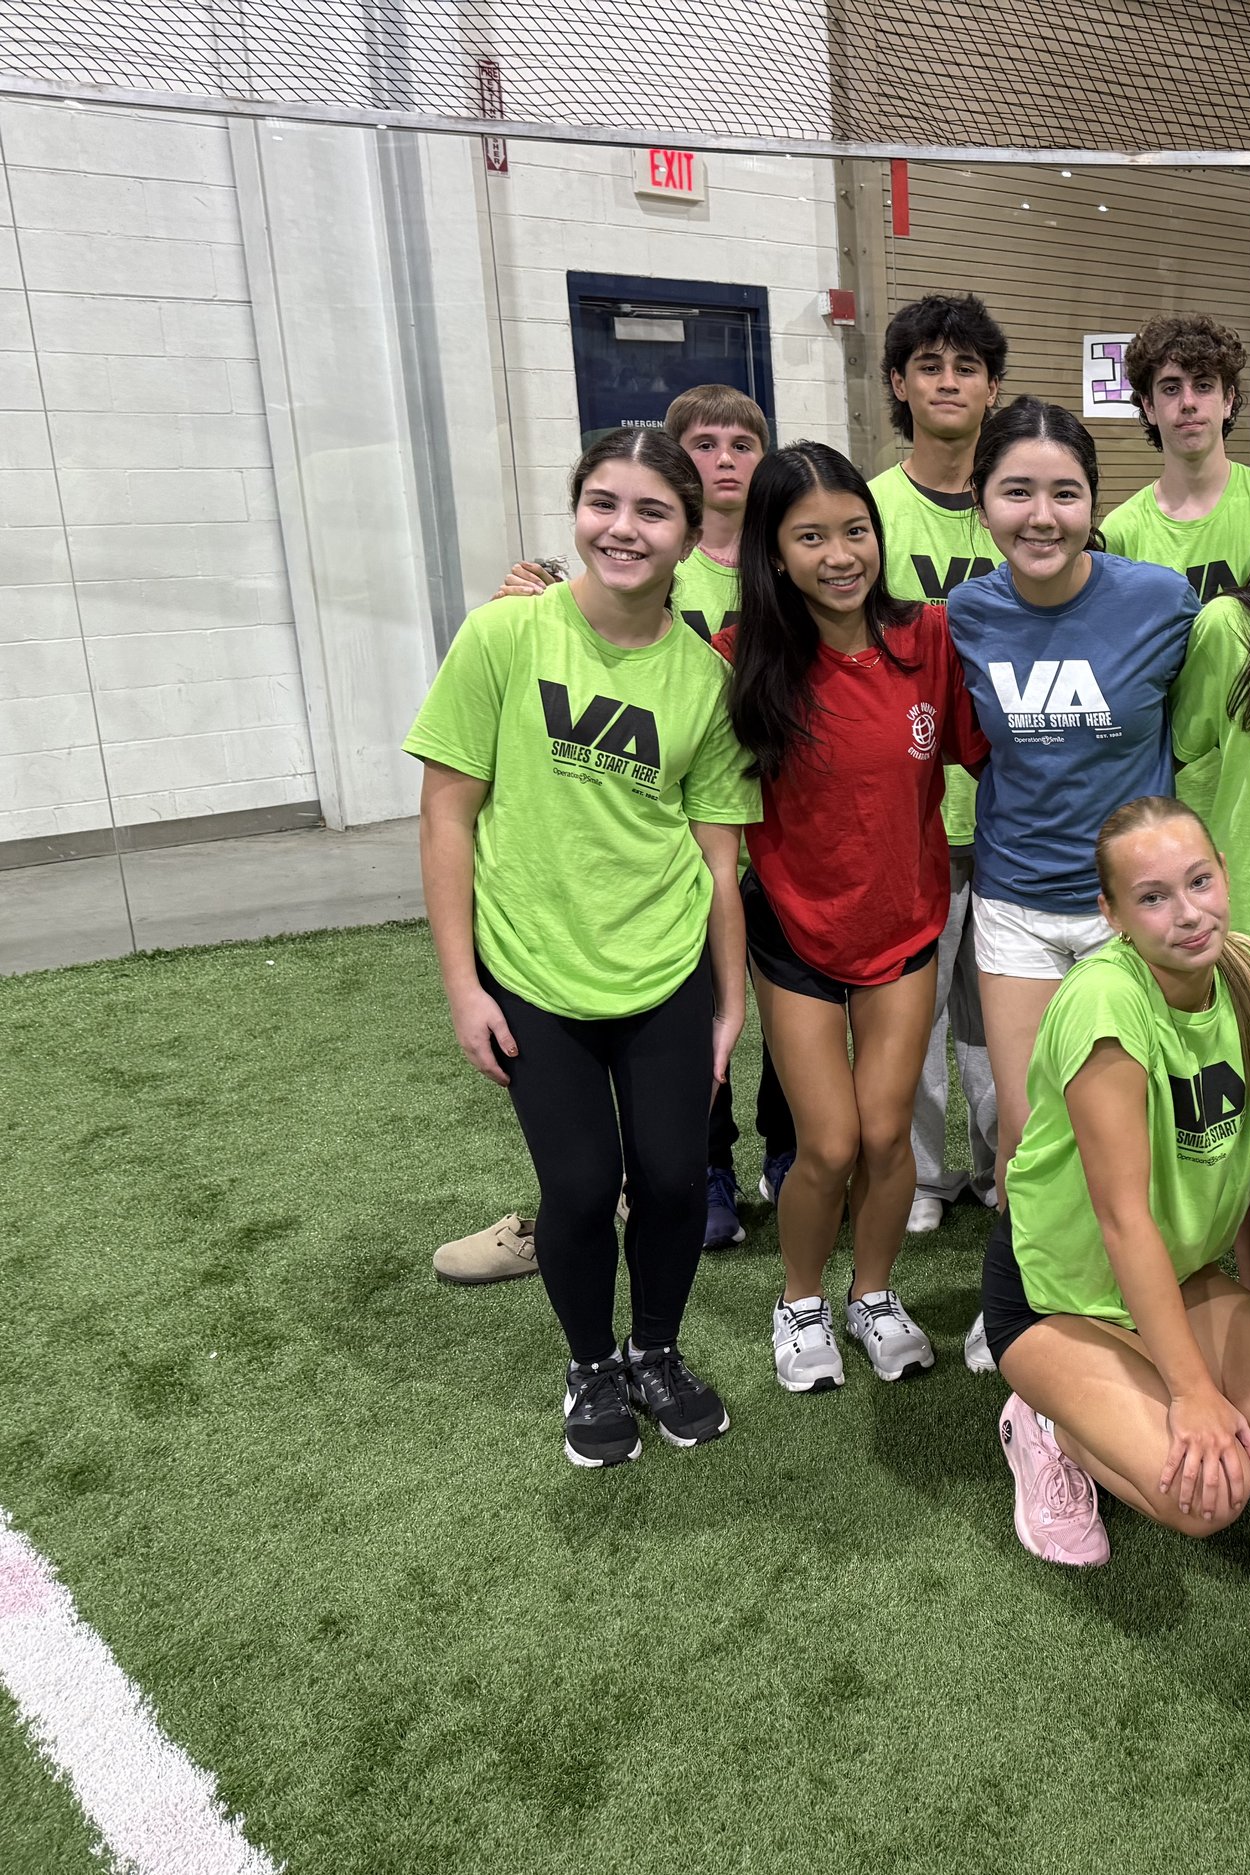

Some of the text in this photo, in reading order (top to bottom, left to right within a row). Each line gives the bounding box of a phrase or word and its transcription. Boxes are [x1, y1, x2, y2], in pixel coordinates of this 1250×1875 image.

[649, 148, 694, 192] EXIT
[988, 659, 1111, 714] VA
[538, 678, 661, 770] VA
[1008, 712, 1113, 729] SMILES START HERE
[551, 740, 660, 785] SMILES START HERE
[1168, 1060, 1246, 1134] VA
[1209, 1119, 1238, 1143] START
